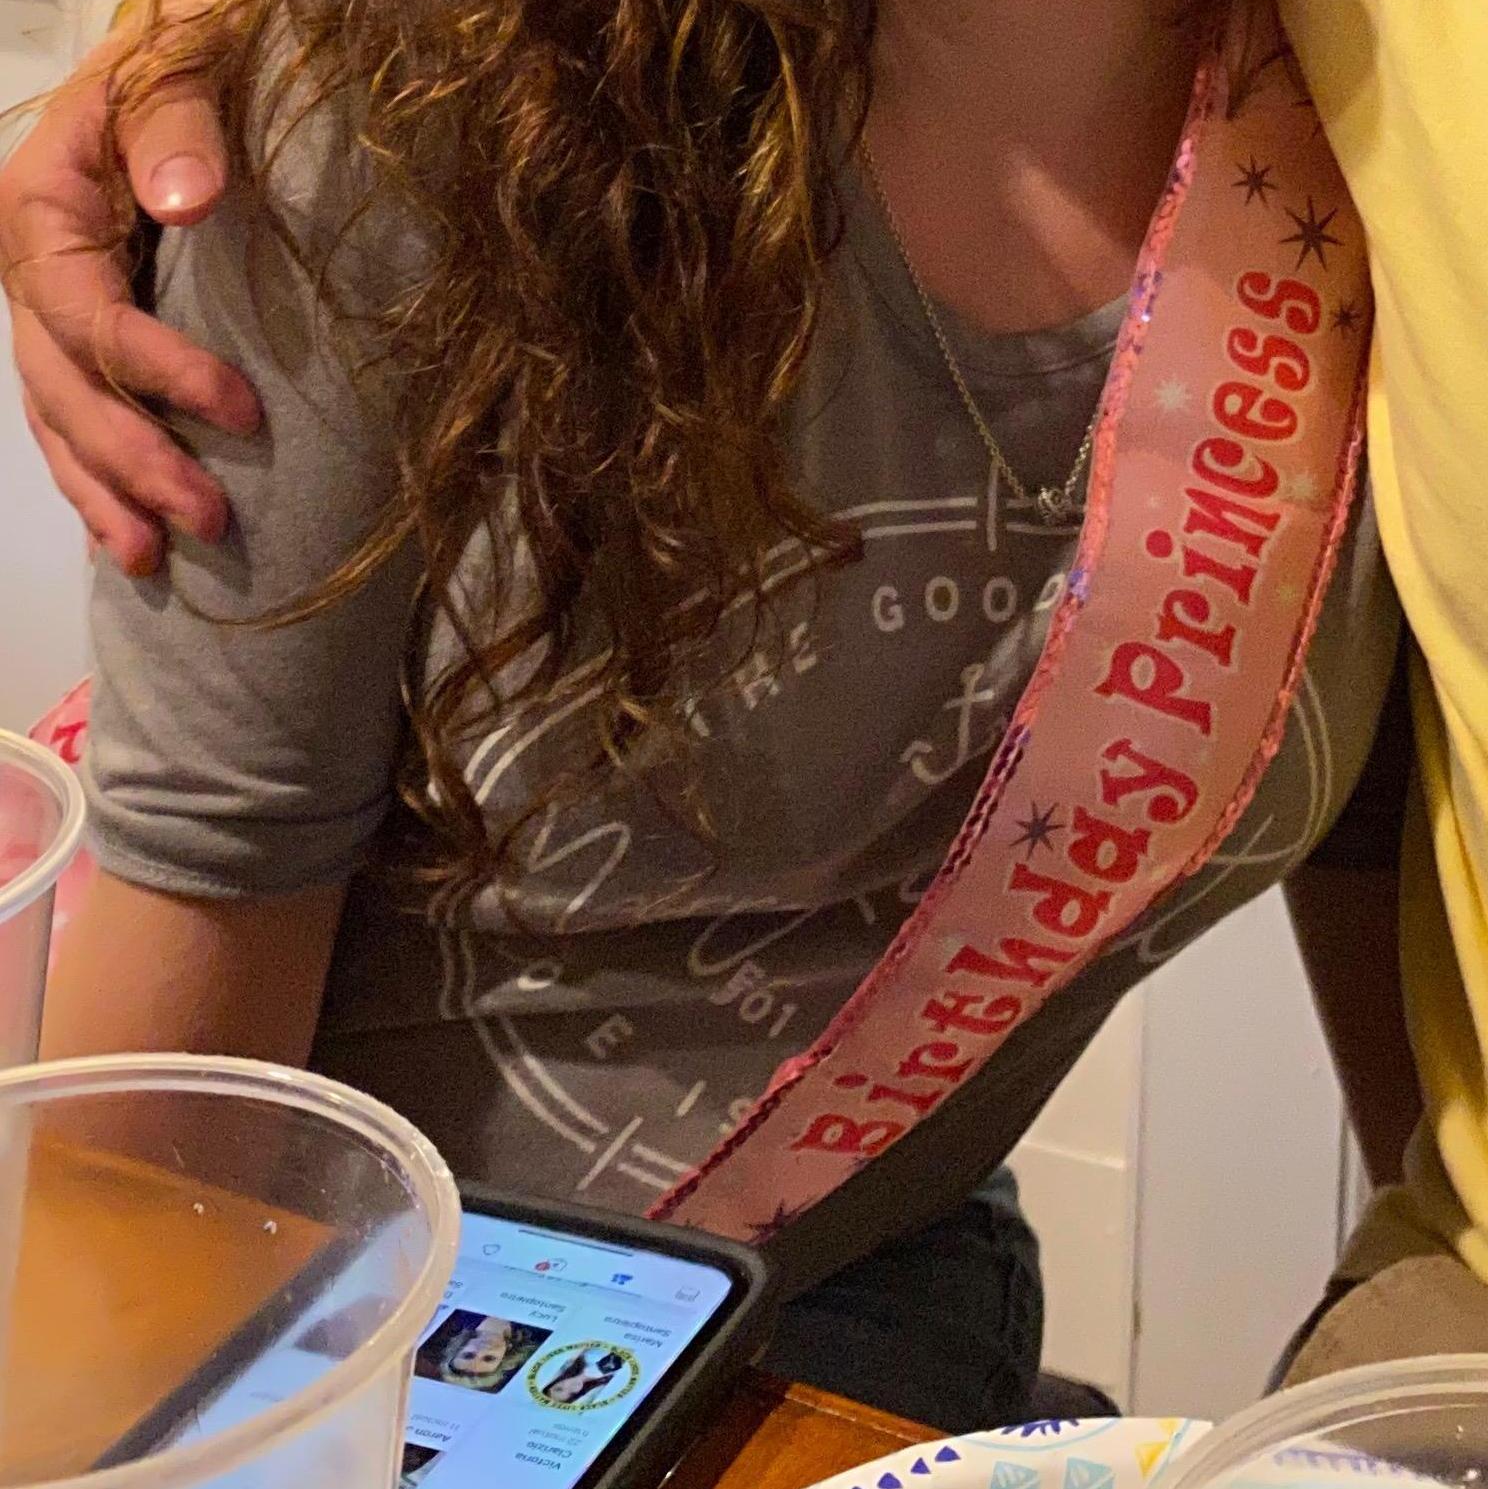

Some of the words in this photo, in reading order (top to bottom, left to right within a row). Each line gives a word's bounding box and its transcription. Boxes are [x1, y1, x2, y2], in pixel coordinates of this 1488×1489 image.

[790, 738, 1199, 1158] Birthday
[1095, 269, 1322, 736] Princess
[514, 1452, 561, 1471] Victoria
